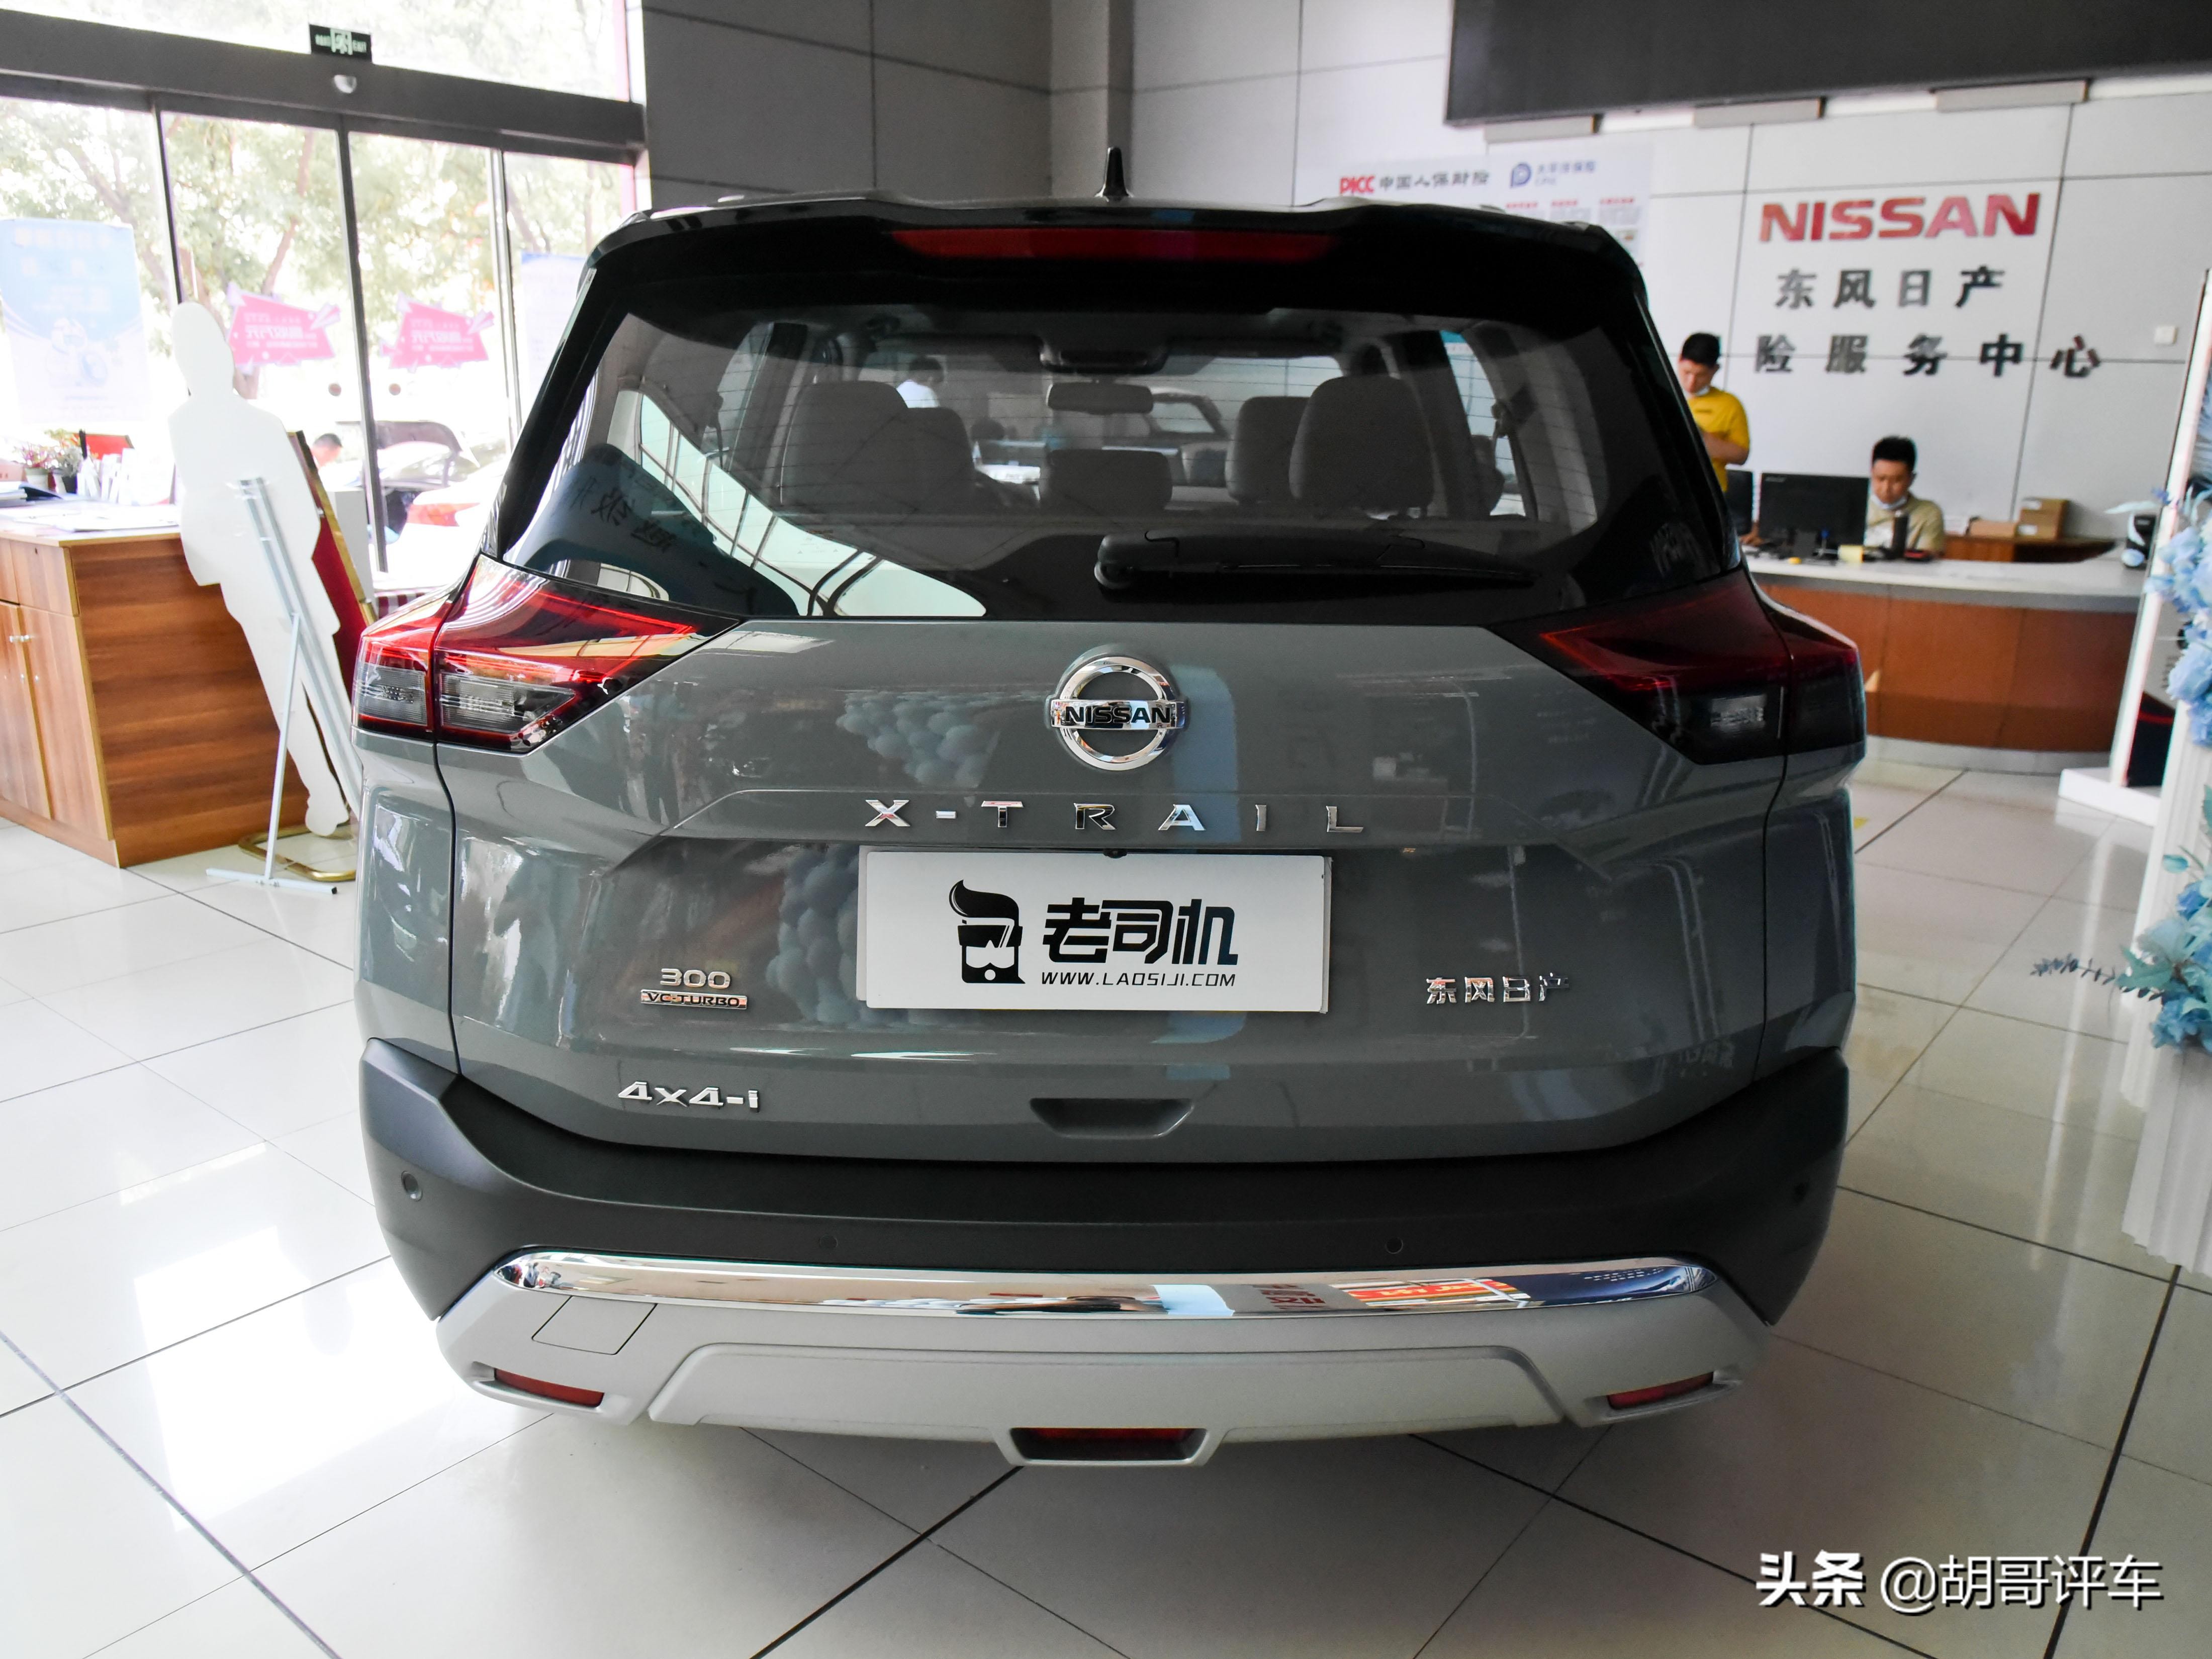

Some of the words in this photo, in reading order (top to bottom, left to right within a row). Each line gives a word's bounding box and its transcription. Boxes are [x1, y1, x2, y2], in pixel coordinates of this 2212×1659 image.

[1340, 174, 1375, 194] PICC
[1760, 193, 2040, 242] NISSAN
[1775, 265, 2005, 309] 东风日产
[1755, 333, 2101, 378] 险服务中心
[1065, 705, 1172, 724] NISSAN
[865, 799, 1364, 834] X-TRAIL
[1043, 897, 1239, 965] 老司机
[660, 967, 730, 989] 300
[1041, 971, 1236, 987] WWW.LAOSIJI.COM
[1426, 972, 1570, 1004] 东风日产
[647, 992, 741, 1007] VC-TURBO
